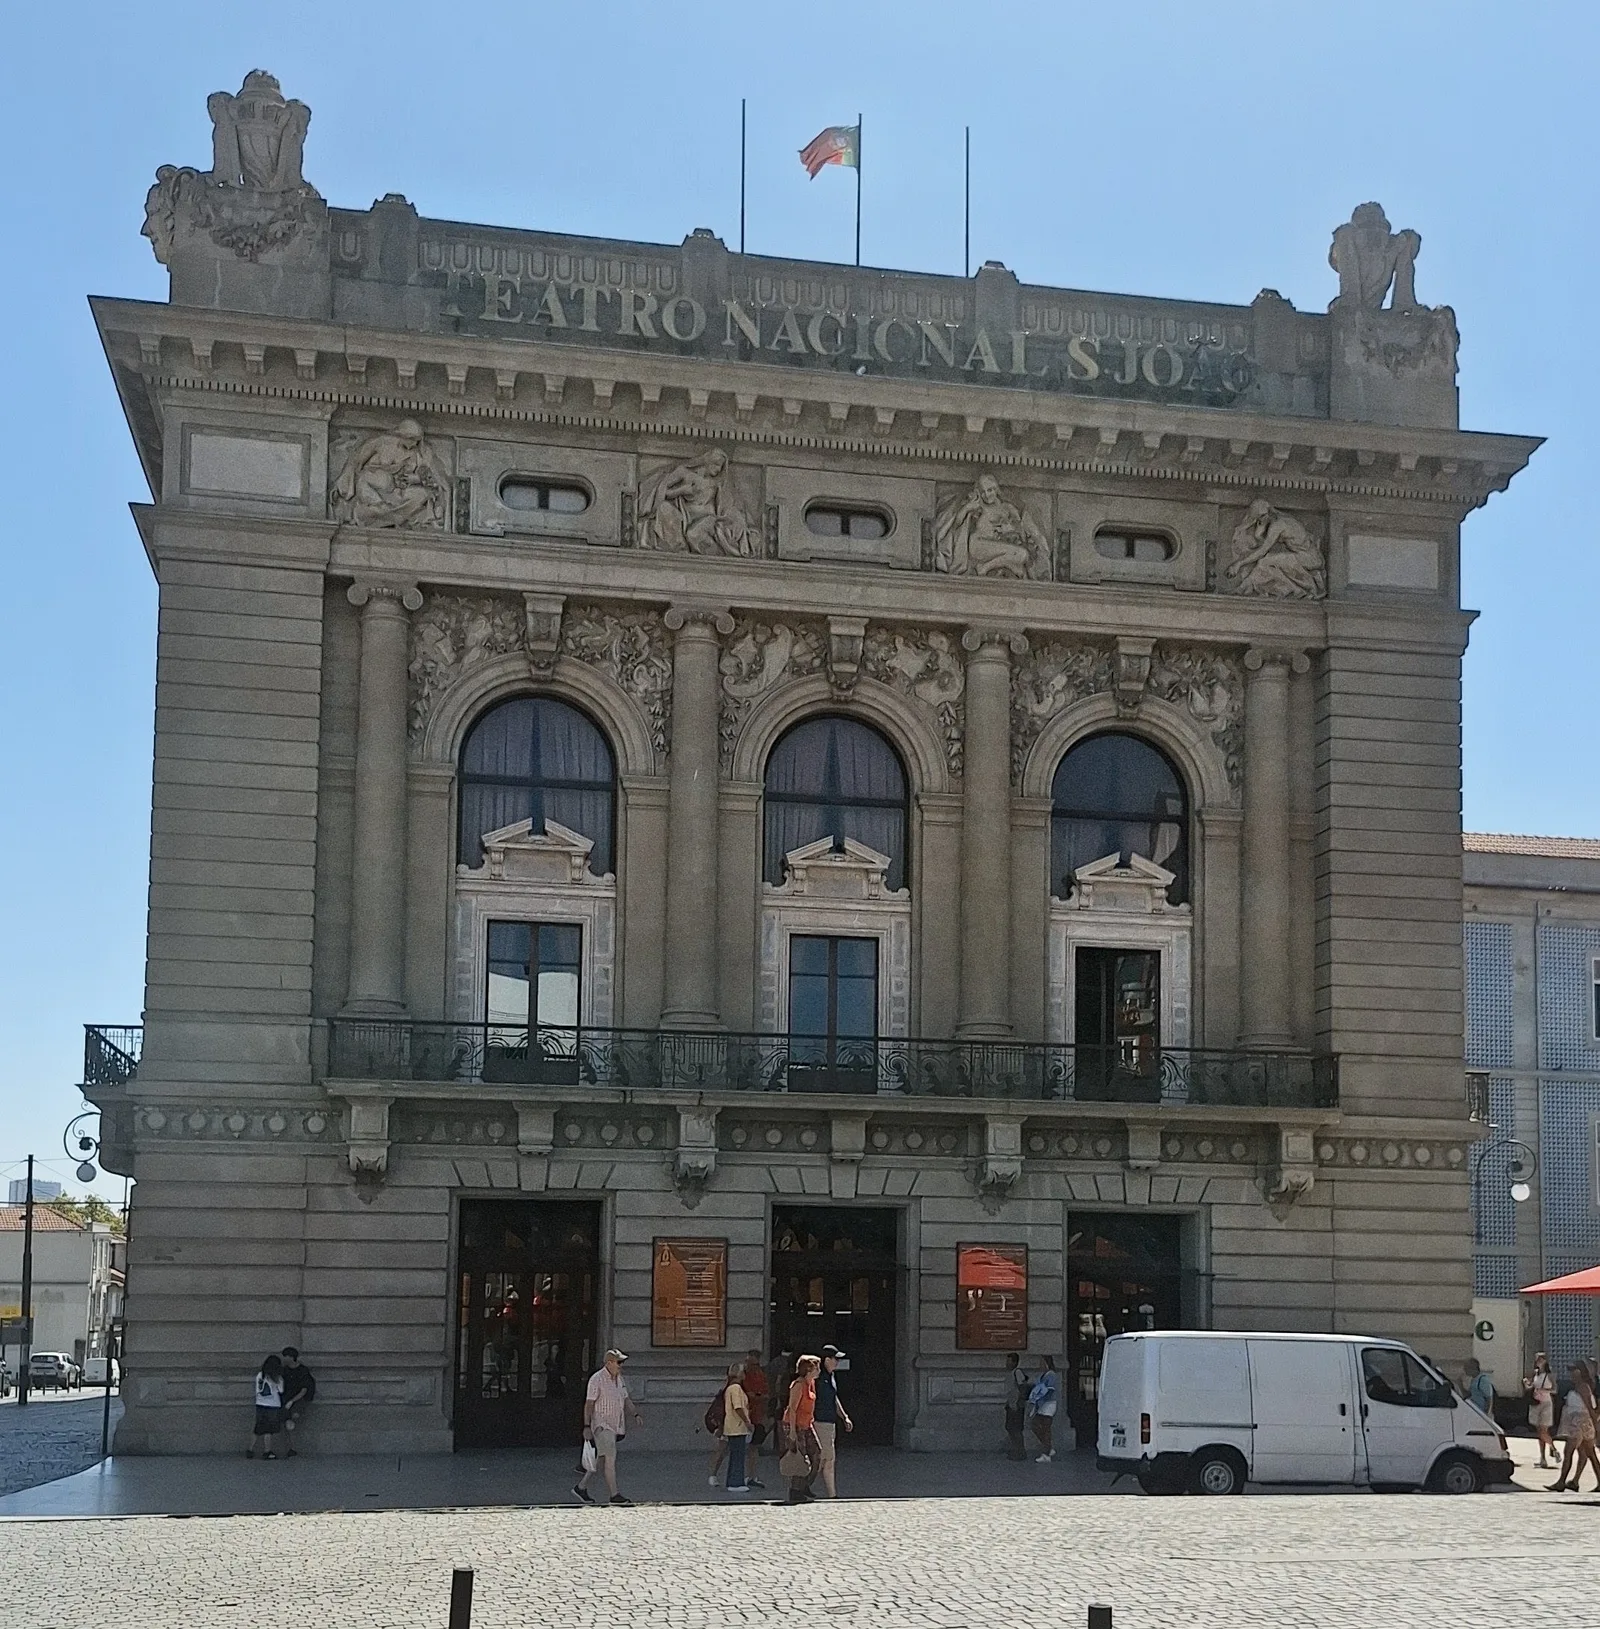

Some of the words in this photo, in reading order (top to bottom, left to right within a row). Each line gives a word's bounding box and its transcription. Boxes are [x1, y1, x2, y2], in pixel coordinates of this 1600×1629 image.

[434, 268, 707, 341] TEATRO
[721, 299, 1049, 377] NACIONAL
[1475, 1320, 1494, 1341] e
